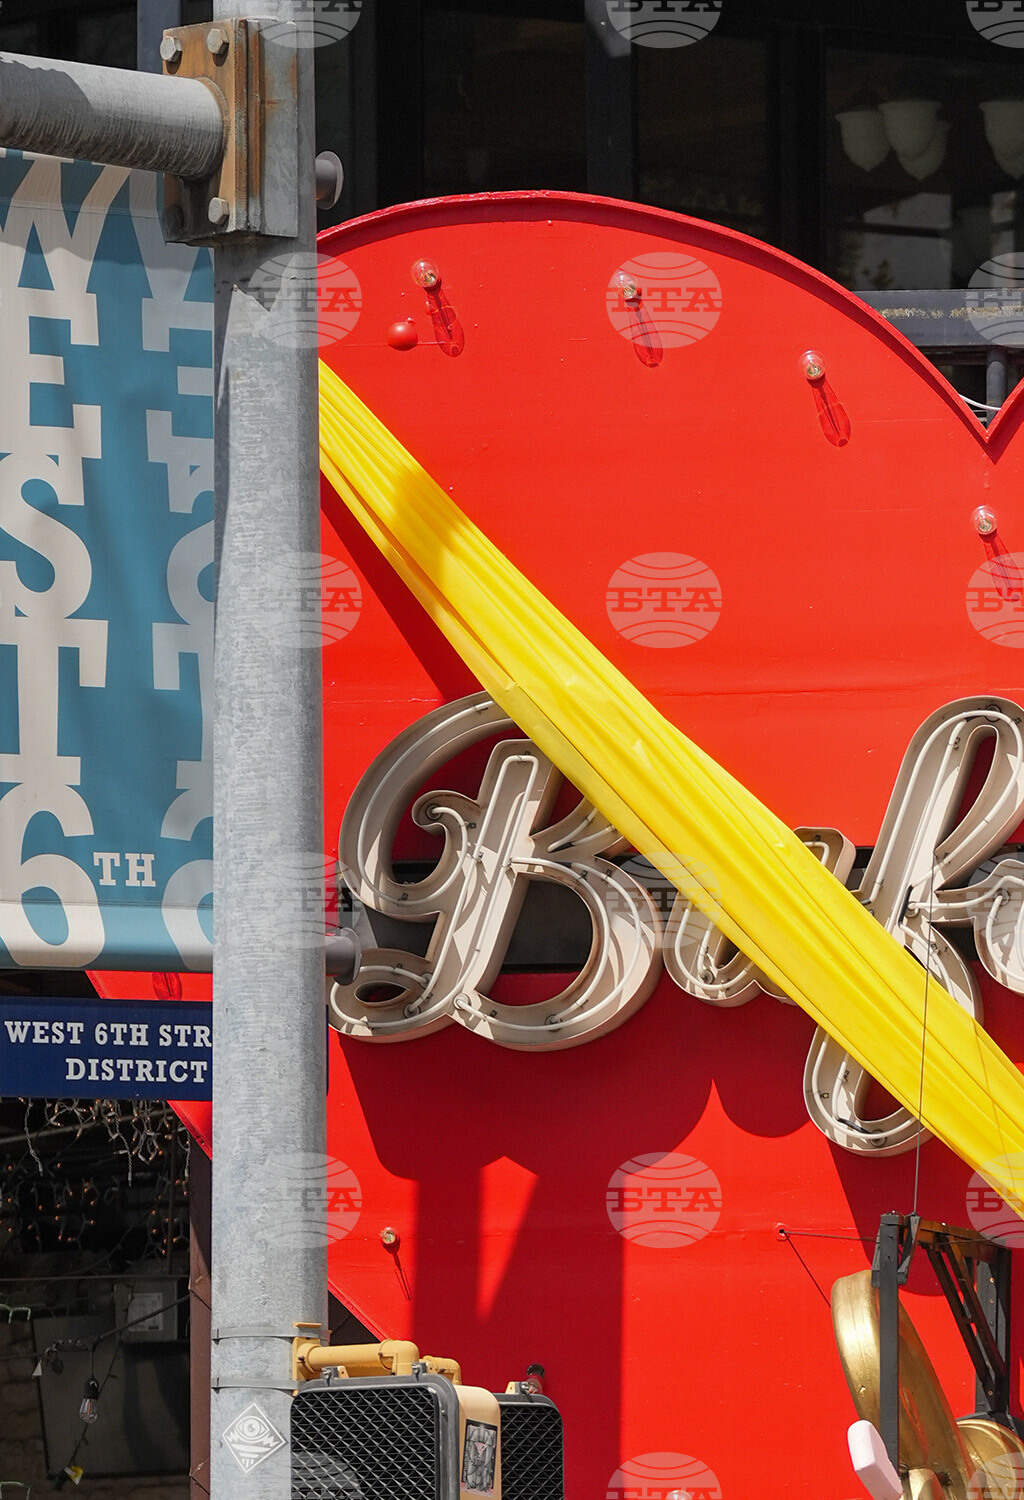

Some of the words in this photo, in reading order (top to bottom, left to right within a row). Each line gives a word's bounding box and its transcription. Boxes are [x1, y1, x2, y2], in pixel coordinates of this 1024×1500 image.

[4, 1021, 84, 1044] WEST
[95, 1022, 149, 1046] 6TH
[159, 1024, 213, 1047] STR
[65, 1058, 207, 1083] DISTRICT
